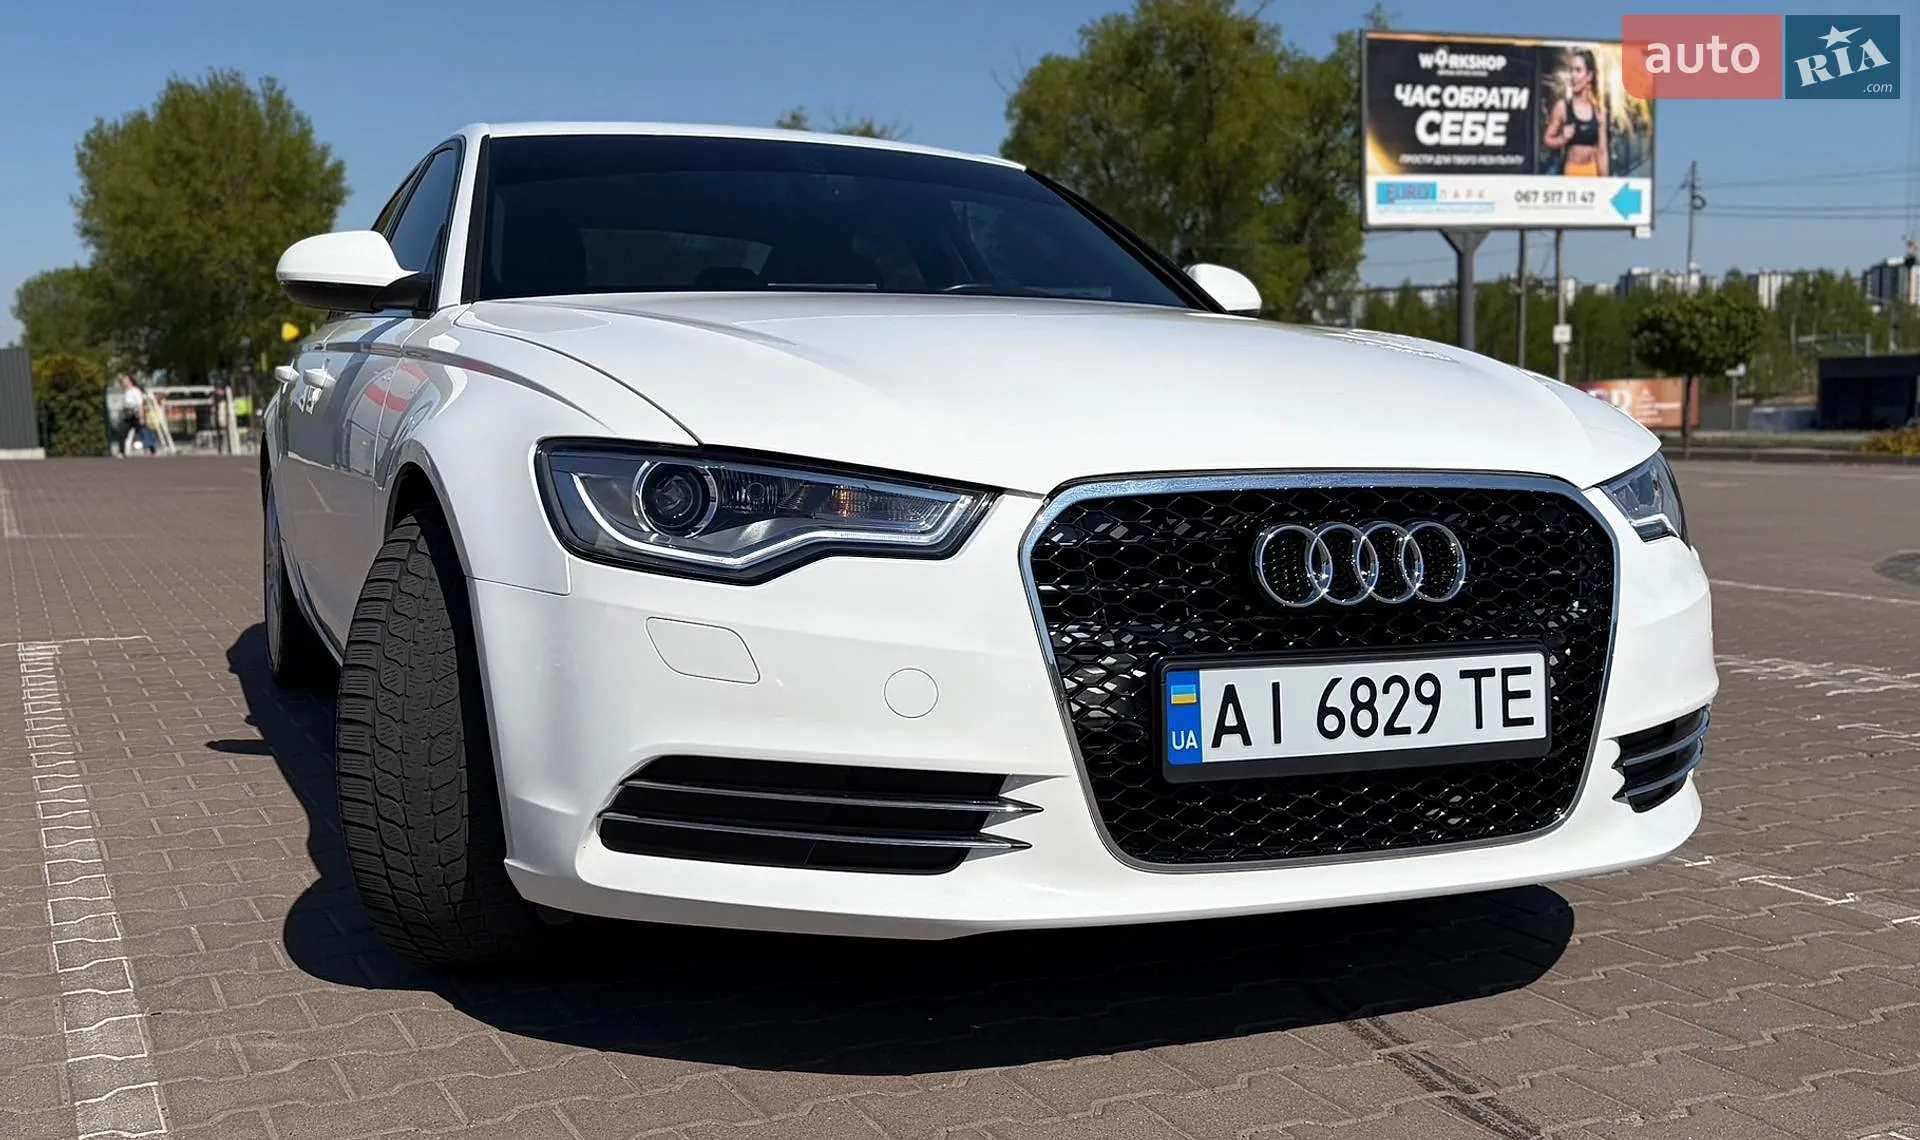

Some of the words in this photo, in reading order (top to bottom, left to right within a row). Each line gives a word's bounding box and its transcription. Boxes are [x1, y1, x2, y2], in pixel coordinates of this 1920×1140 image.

[1418, 47, 1507, 71] WORKSHOP
[1394, 83, 1441, 108] ЧАС
[1442, 84, 1530, 110] ОБРАТИ
[1415, 110, 1509, 146] СЕБЕ
[1514, 190, 1539, 203] 067
[1543, 190, 1563, 204] 577
[1567, 190, 1577, 204] 11
[1580, 190, 1596, 204] 47
[1211, 681, 1283, 749] AI
[1316, 673, 1442, 740] 6829
[1459, 666, 1535, 730] TE
[1171, 730, 1199, 751] UA
